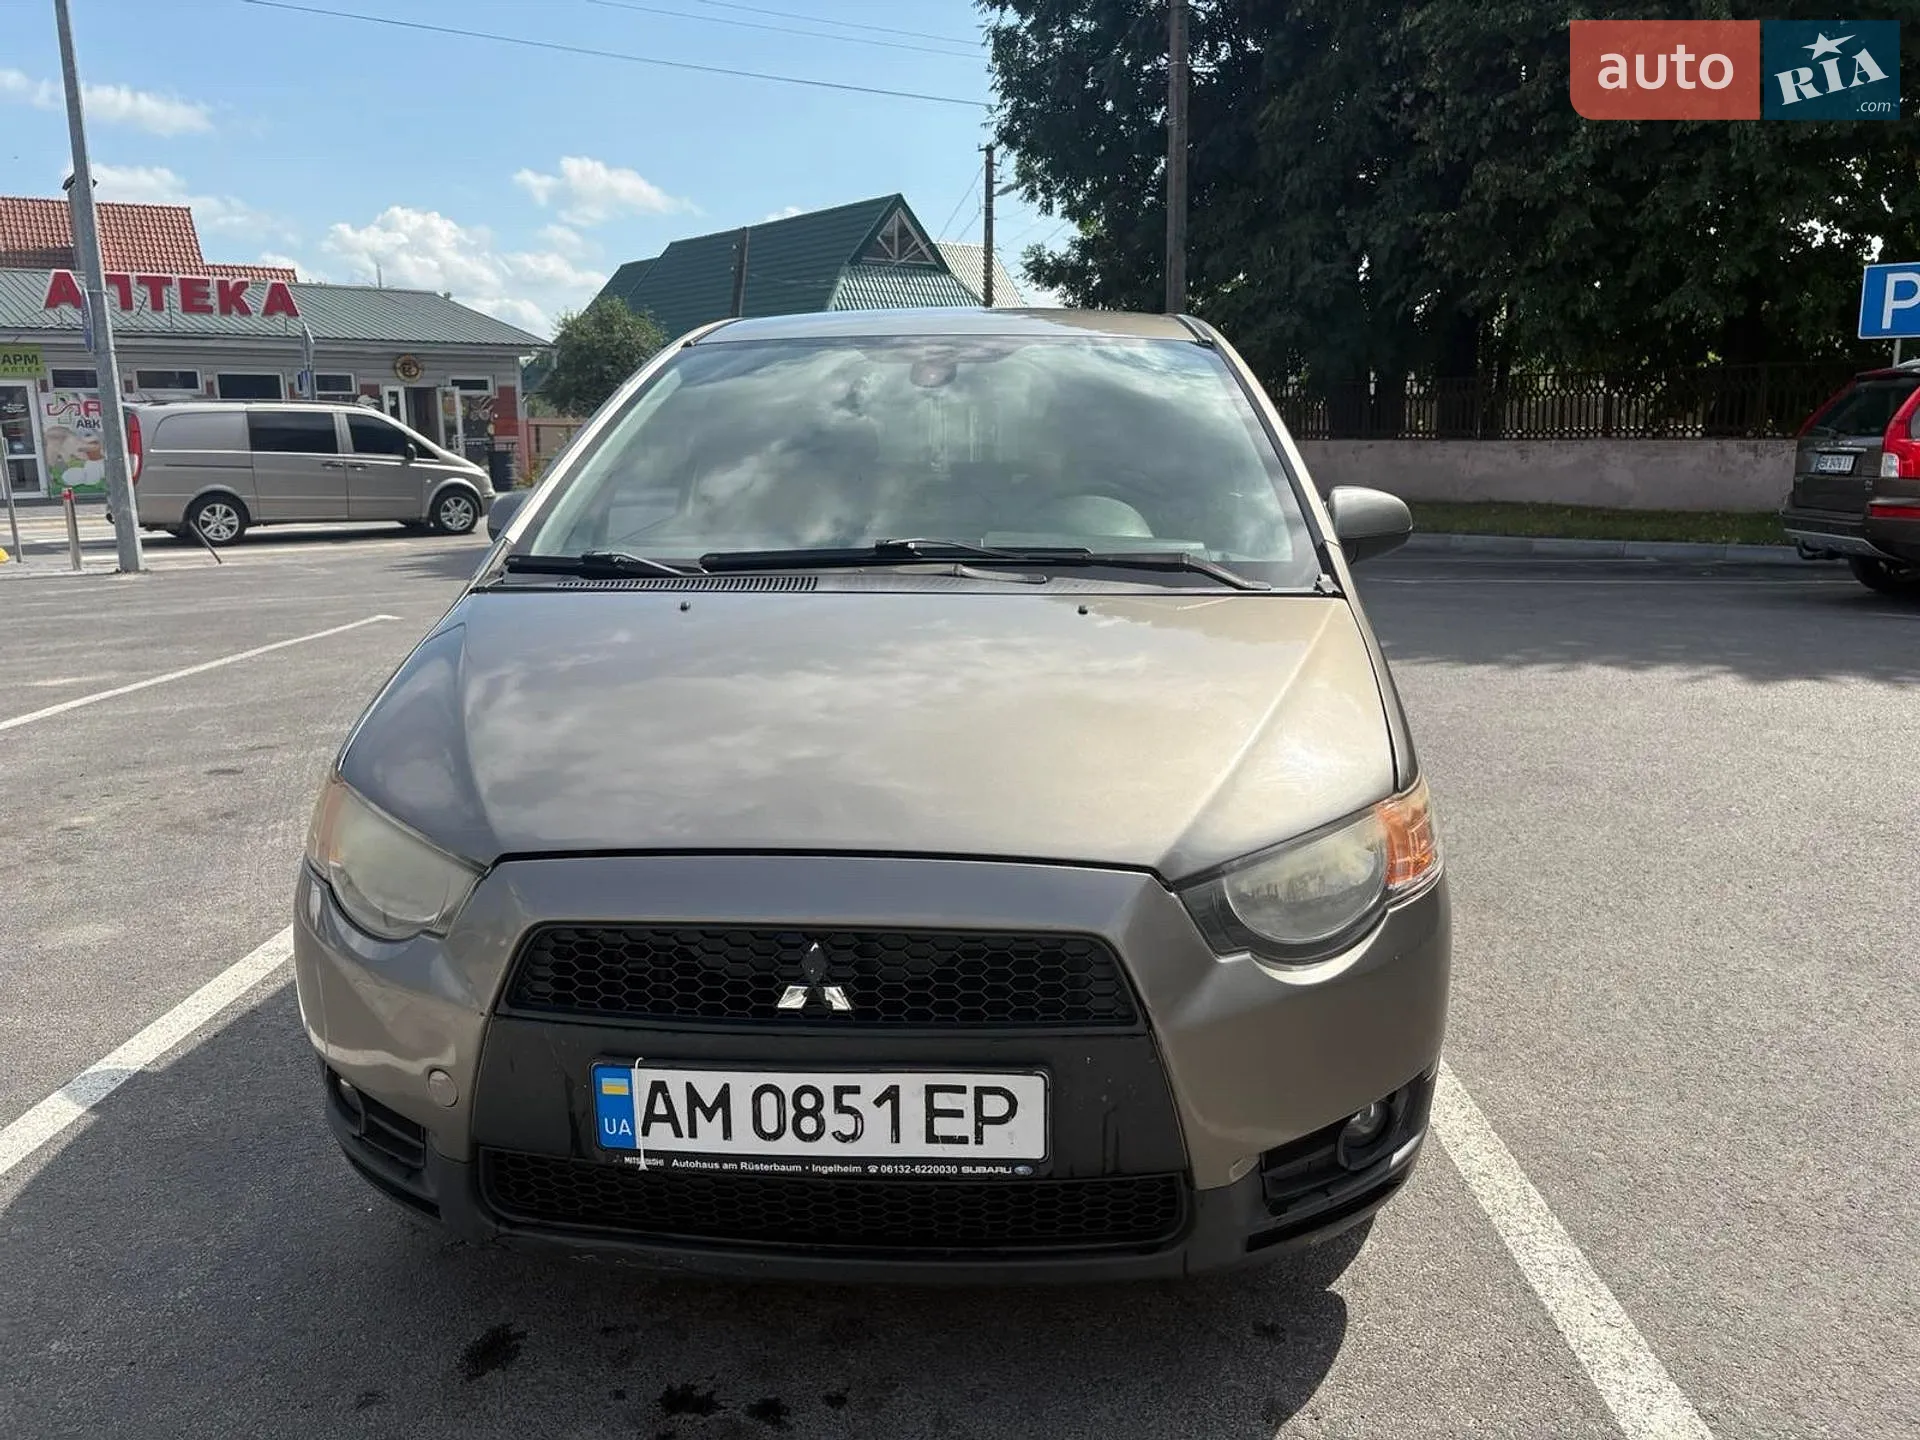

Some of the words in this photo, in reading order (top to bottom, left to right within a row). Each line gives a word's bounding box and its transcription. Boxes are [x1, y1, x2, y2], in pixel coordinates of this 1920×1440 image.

[43, 268, 301, 318] АПТЕКА
[1881, 272, 1920, 330] P
[604, 1117, 633, 1137] UA
[641, 1079, 733, 1141] AM
[751, 1082, 901, 1145] 0851
[924, 1083, 1020, 1147] EP
[671, 1158, 720, 1170] Autohaus
[722, 1161, 738, 1170] am
[740, 1160, 802, 1173] Rüsterbaum
[811, 1163, 862, 1175] Ingelheim
[880, 1164, 958, 1175] 06132-6220030
[961, 1165, 1012, 1175] SUBARU
